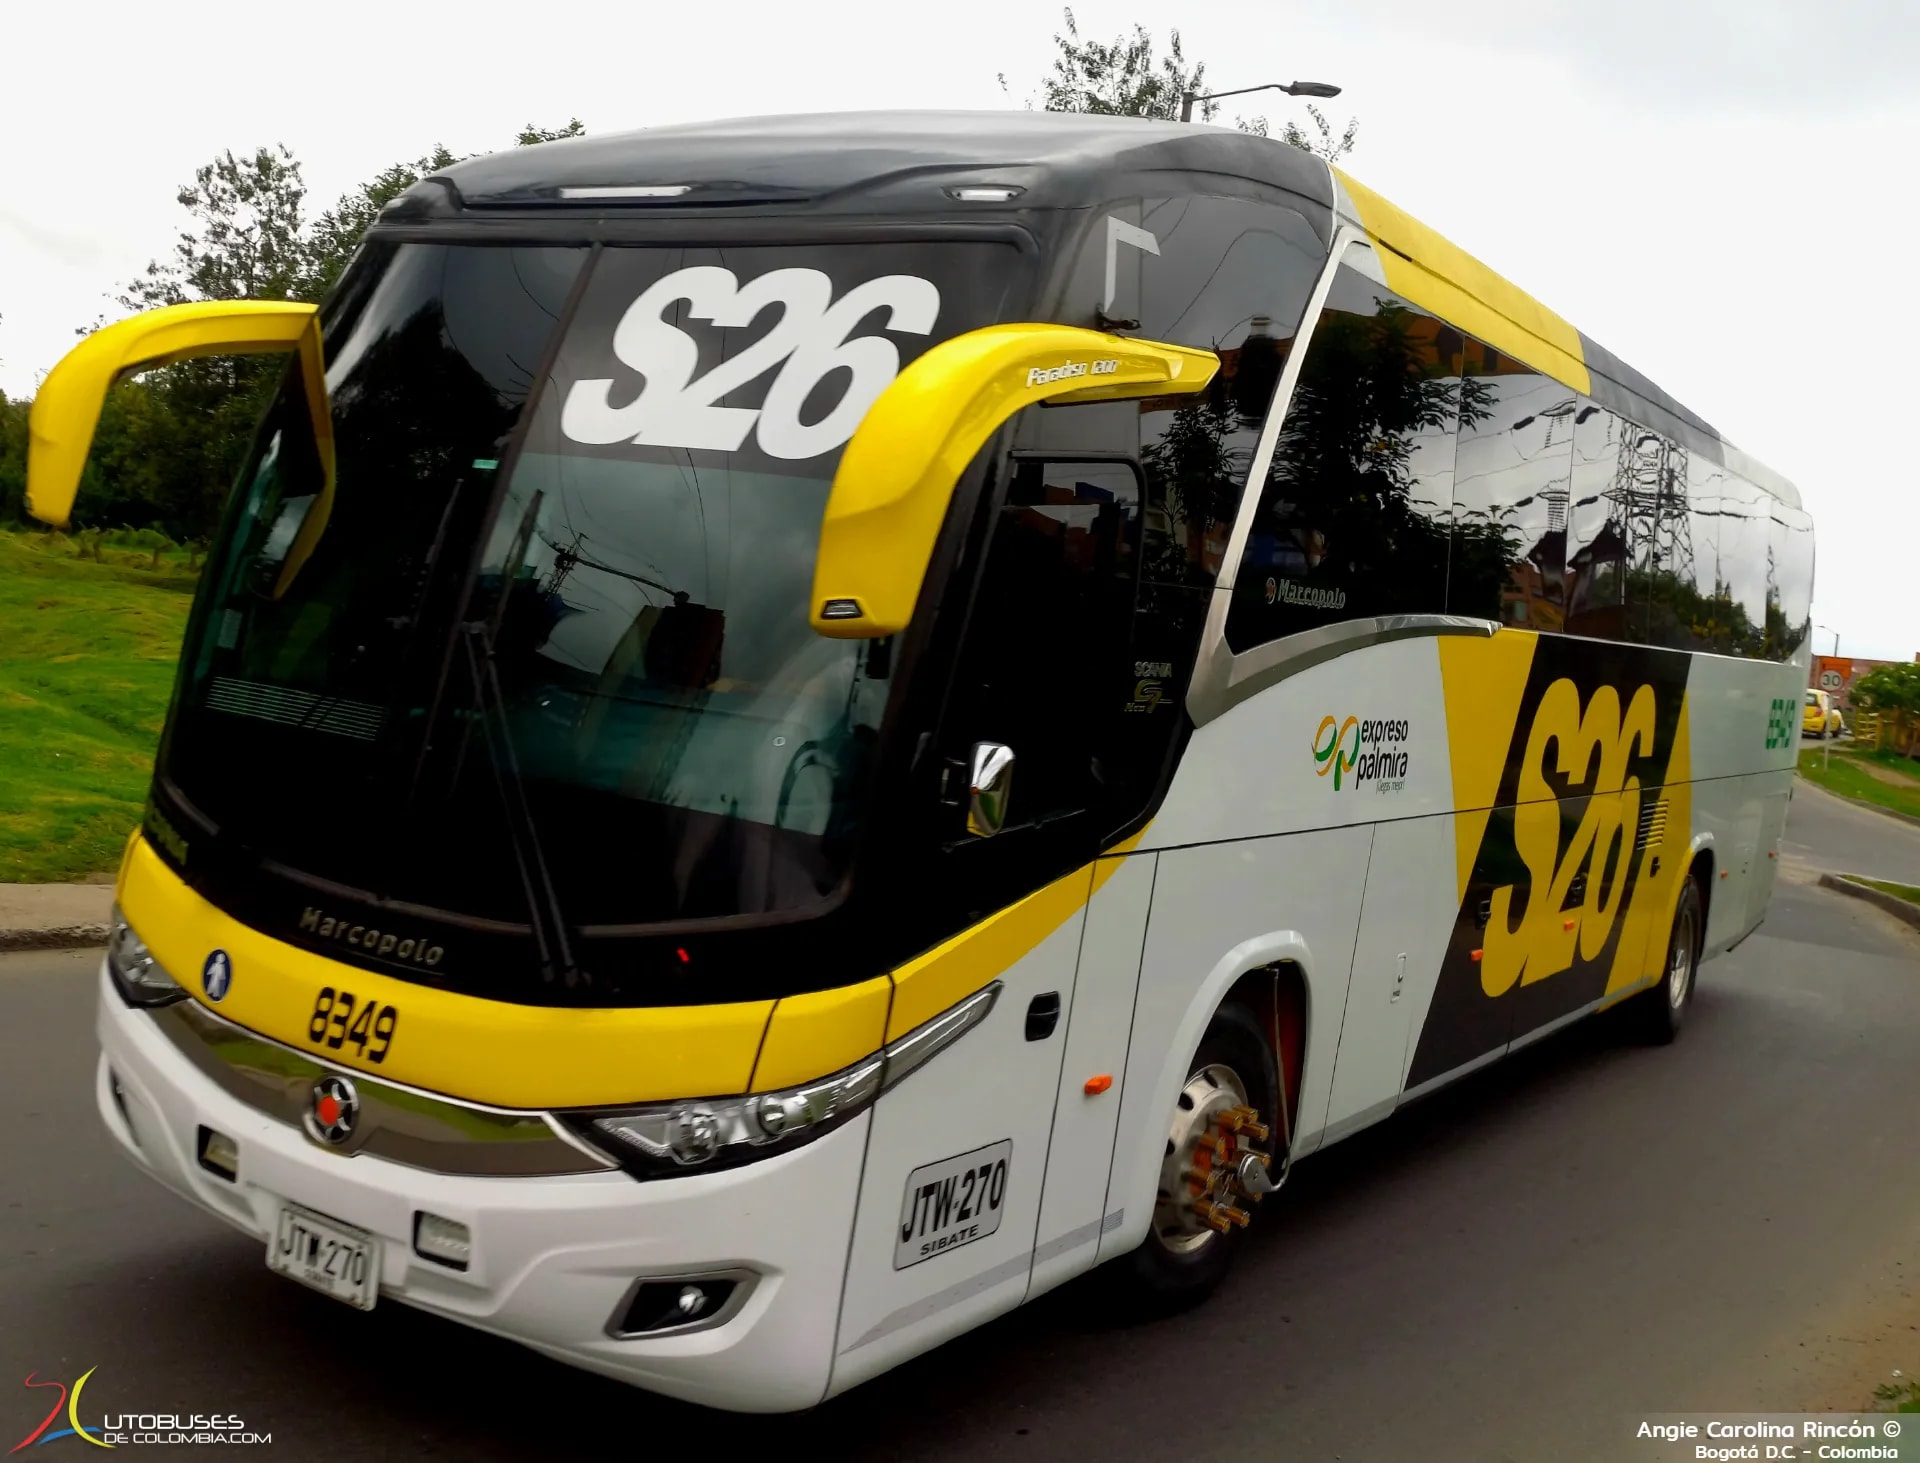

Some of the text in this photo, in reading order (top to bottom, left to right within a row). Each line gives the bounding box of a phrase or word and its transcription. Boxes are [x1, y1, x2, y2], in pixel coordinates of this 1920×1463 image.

[561, 266, 940, 460] S26
[1278, 578, 1346, 609] Marcopolo
[1822, 674, 1841, 687] 30
[1361, 719, 1409, 752] expreso
[1355, 745, 1408, 790] palmira
[1480, 677, 1656, 998] S26
[299, 906, 444, 966] Marcopolo
[308, 986, 398, 1065] 8349
[920, 1223, 980, 1256] SIBATE
